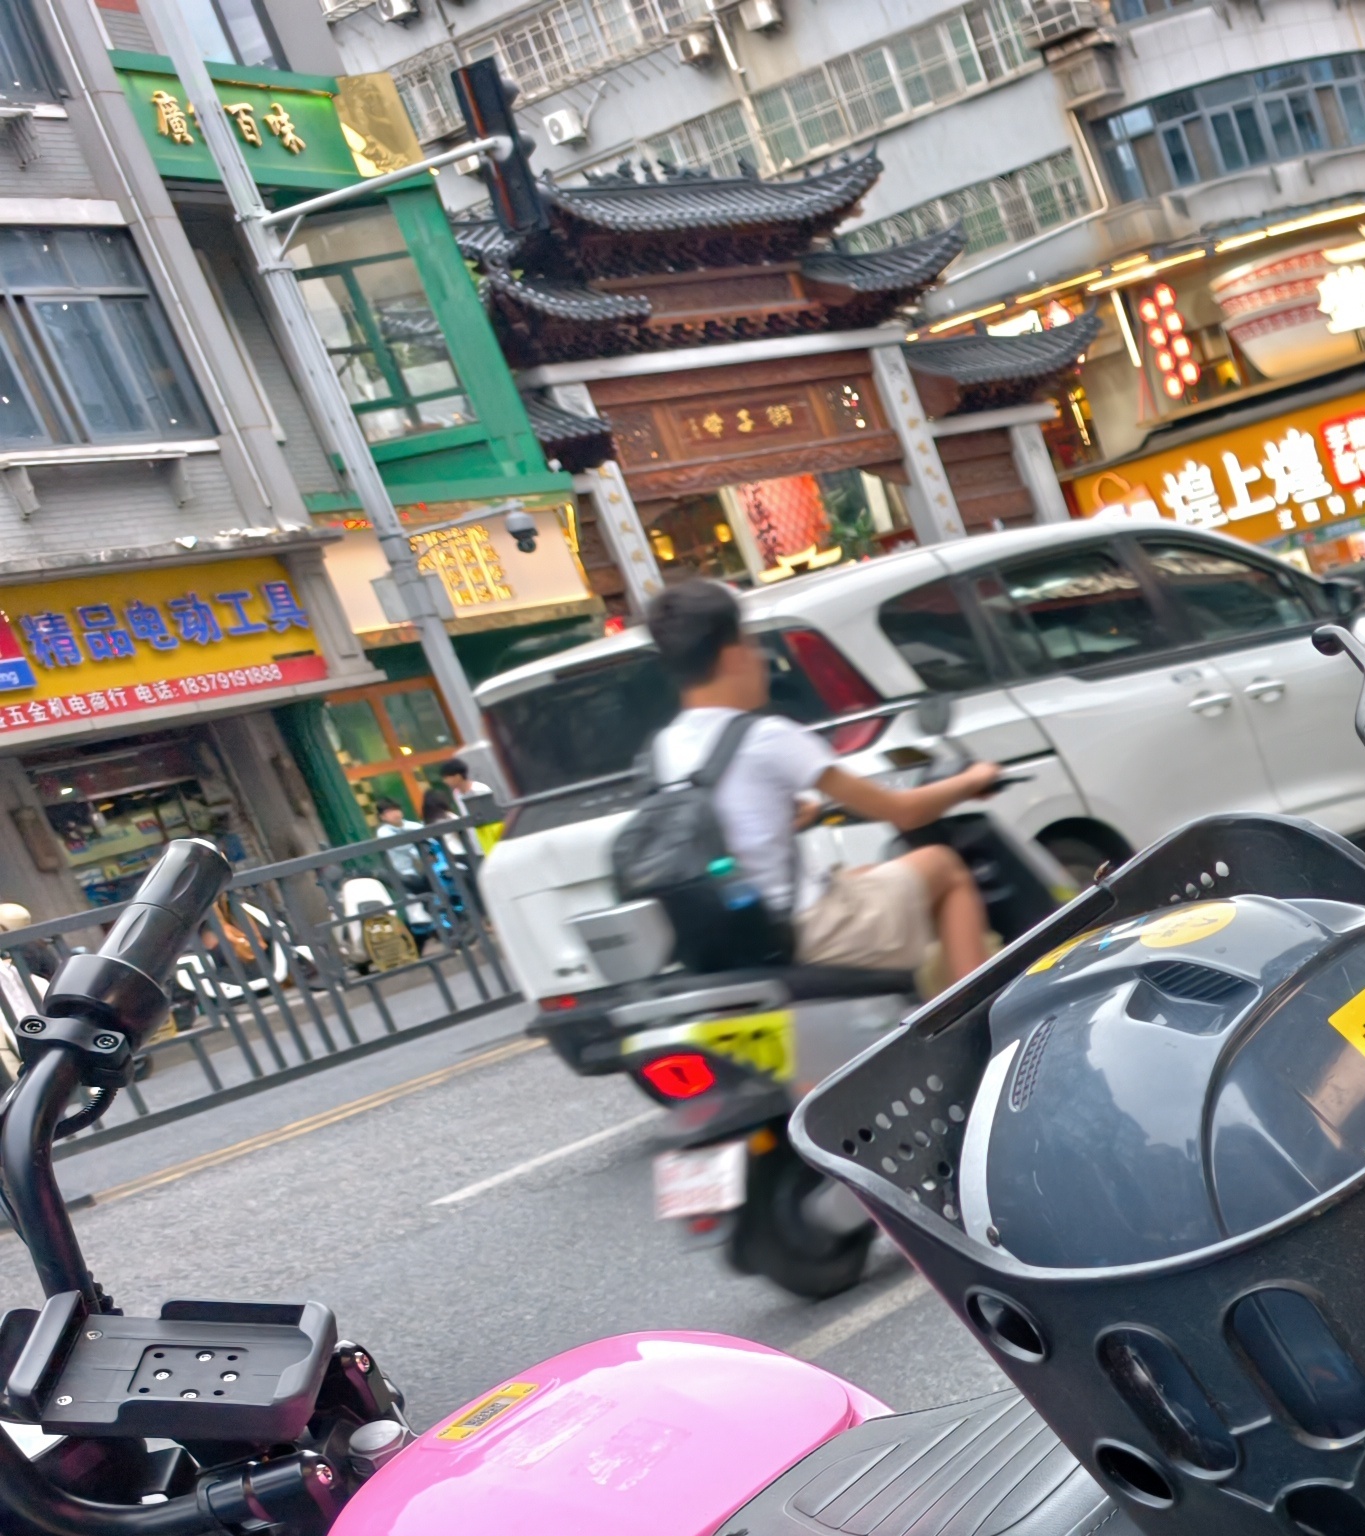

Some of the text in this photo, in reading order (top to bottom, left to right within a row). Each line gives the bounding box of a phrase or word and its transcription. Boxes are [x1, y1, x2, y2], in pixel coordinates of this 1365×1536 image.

[152, 90, 306, 155] 廣百味
[20, 580, 311, 669] 精品电动工具
